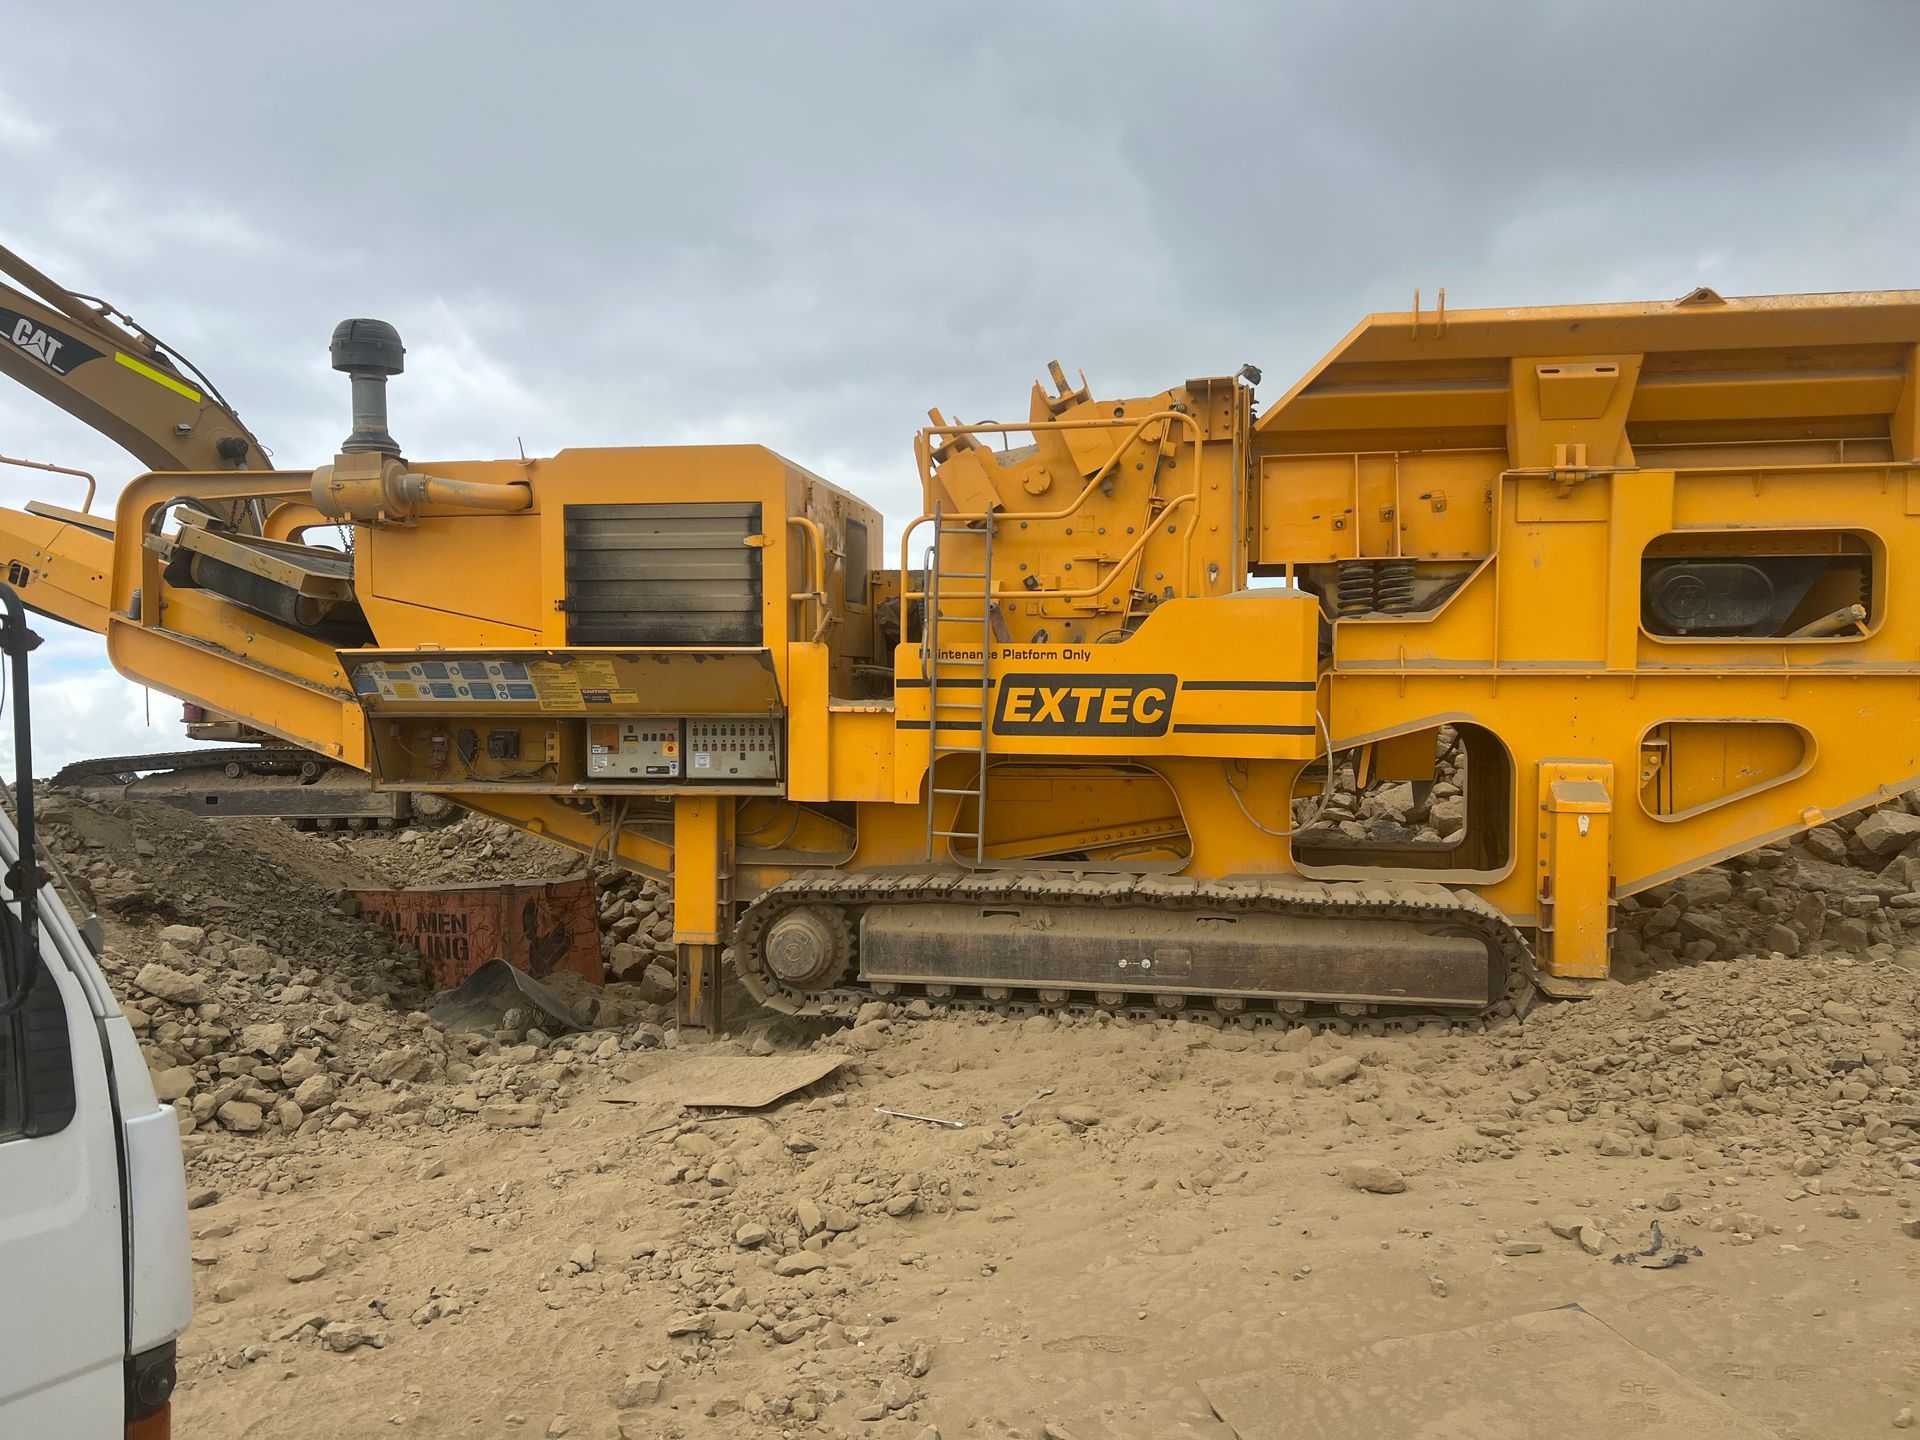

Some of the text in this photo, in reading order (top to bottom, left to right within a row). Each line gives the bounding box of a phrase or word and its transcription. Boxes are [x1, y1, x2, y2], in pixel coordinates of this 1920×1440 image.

[12, 318, 64, 365] CAT
[919, 649, 1091, 662] Mintenane Platform Only
[1002, 687, 1167, 724] EXTEC
[361, 911, 468, 934] TAL MEN
